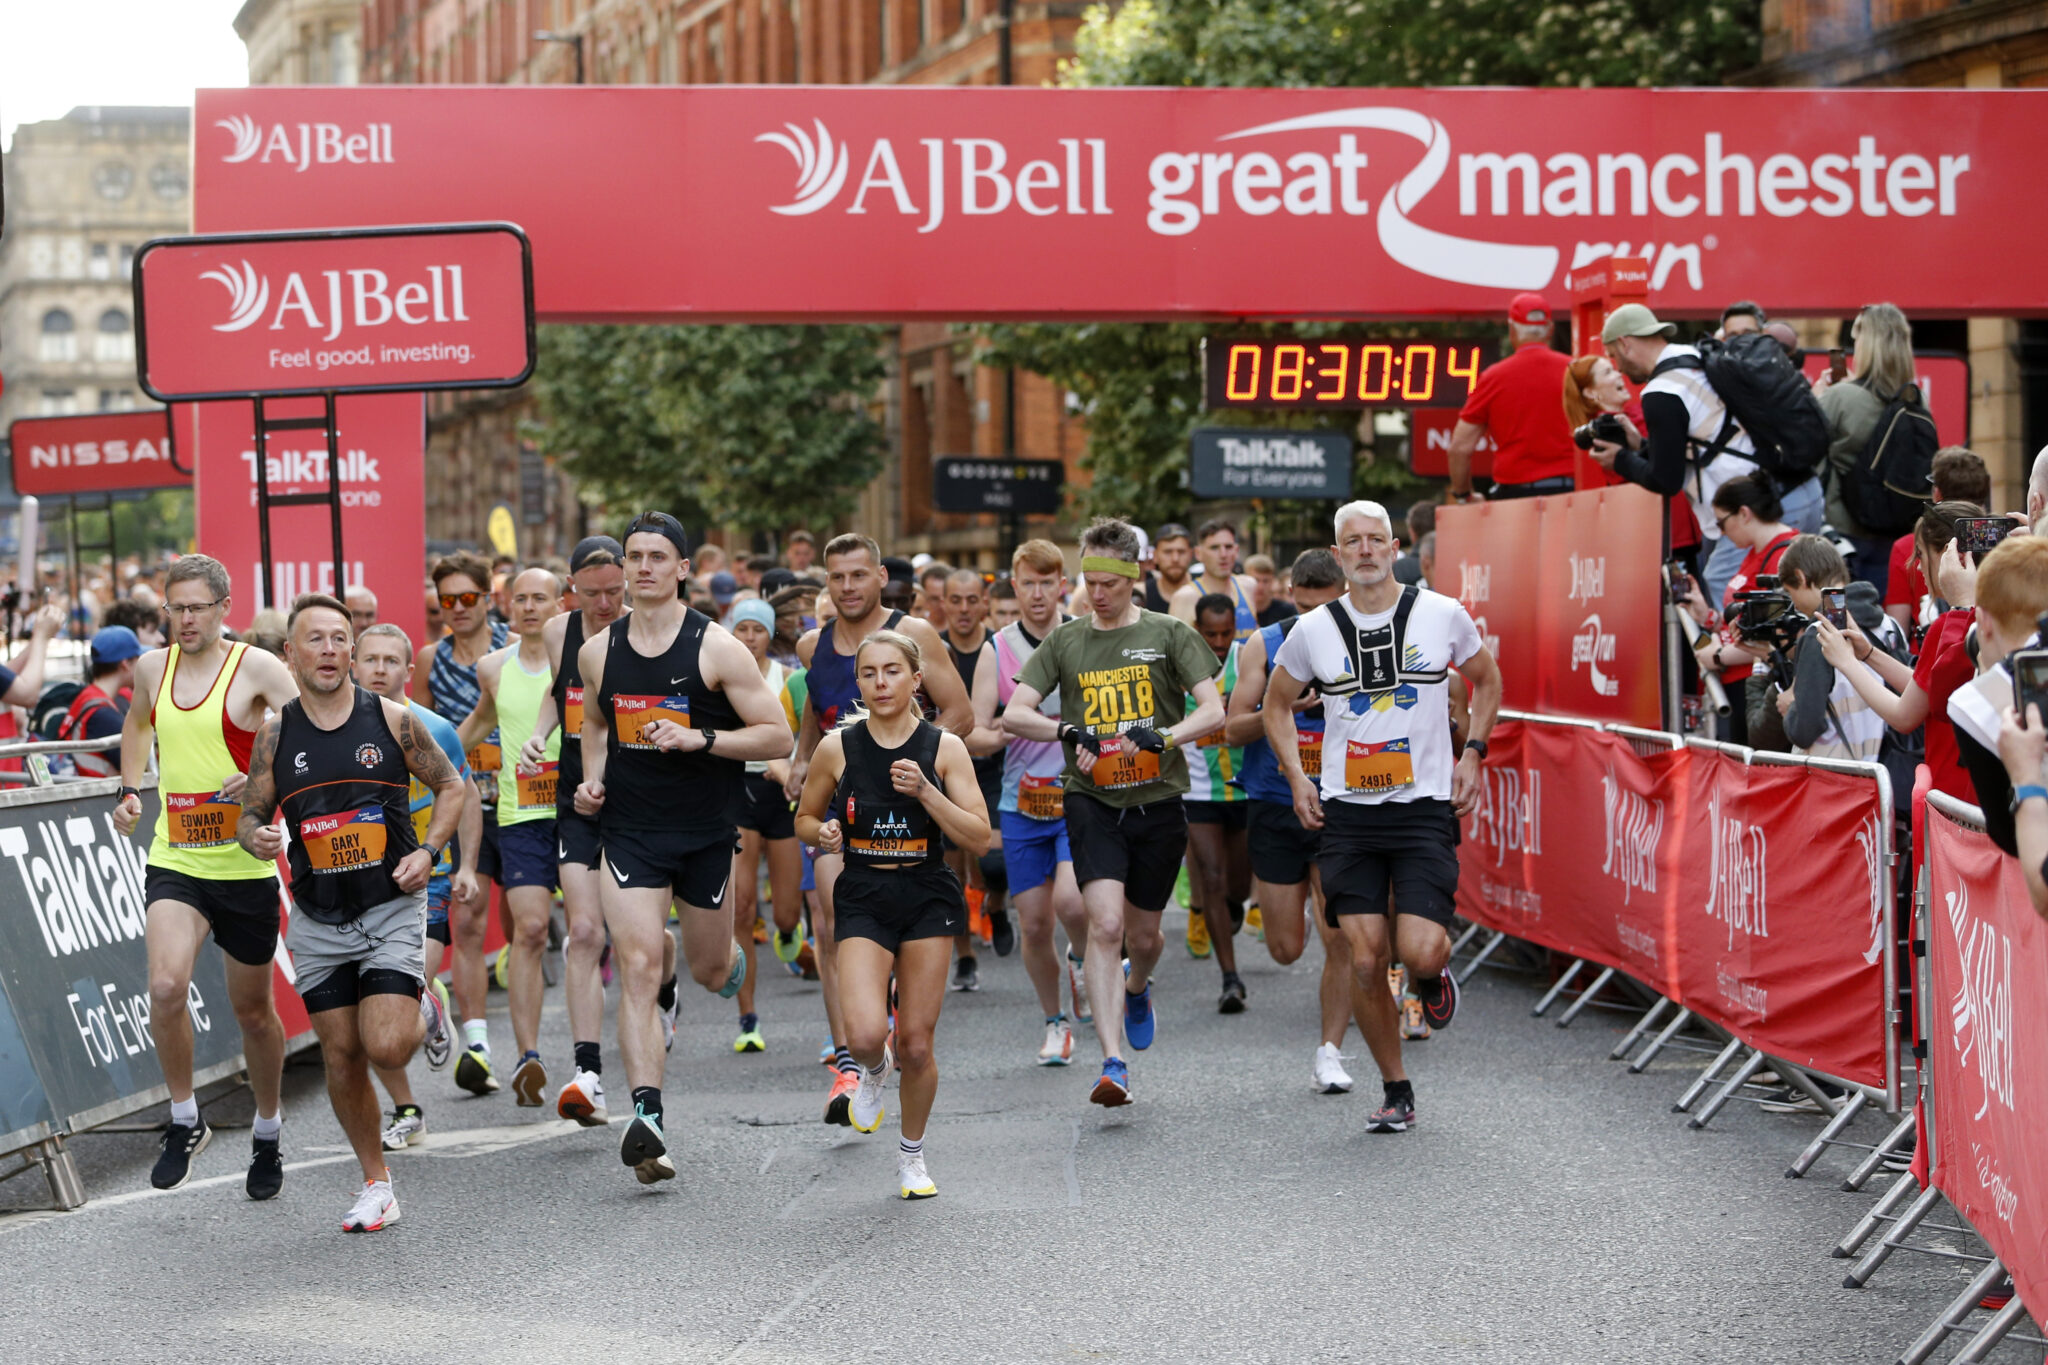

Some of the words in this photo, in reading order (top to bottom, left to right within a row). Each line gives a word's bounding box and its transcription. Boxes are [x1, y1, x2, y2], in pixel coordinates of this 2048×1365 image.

[1147, 134, 1369, 236] great
[1458, 132, 1971, 218] manchester
[268, 264, 471, 342] AJBell
[269, 348, 312, 368] Feel
[315, 345, 375, 371] good,
[380, 341, 476, 365] investing.
[1226, 344, 1481, 401] 08:30:04
[1217, 438, 1326, 469] TalkTalk
[241, 449, 381, 483] TalkTlk
[1223, 468, 1252, 486] For
[1253, 468, 1327, 490] Everyone
[1078, 664, 1151, 688] MANCHESTER
[1082, 680, 1155, 725] 2018
[1096, 722, 1118, 735] YOUR
[1118, 756, 1136, 769] TIM
[1112, 768, 1143, 784] 22517
[1360, 773, 1393, 787] 24916
[181, 811, 225, 828] EDWARD
[187, 826, 222, 842] 23476
[331, 833, 360, 851] GARY
[331, 847, 368, 867] 21204
[68, 993, 119, 1068] For
